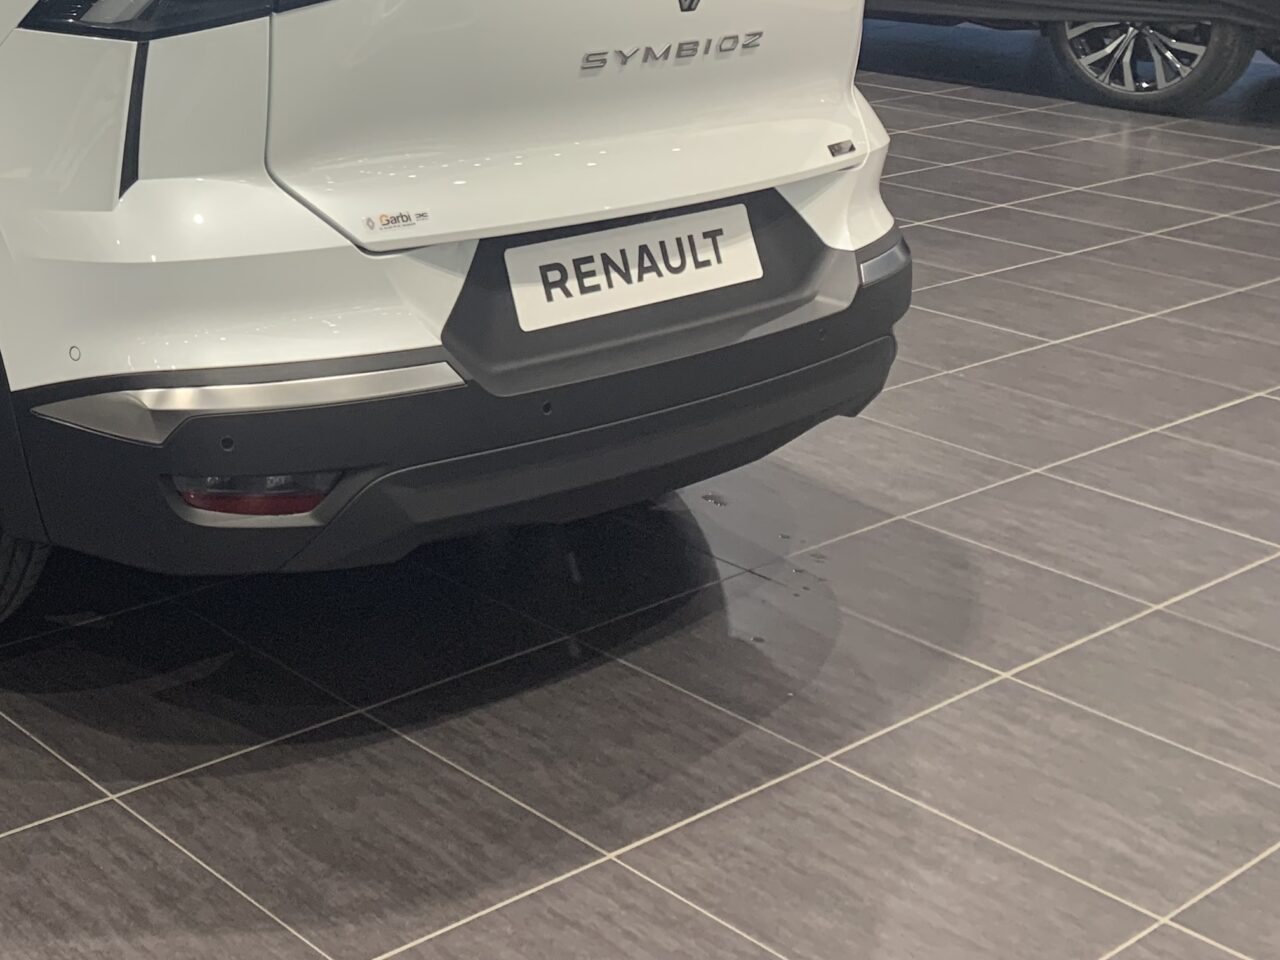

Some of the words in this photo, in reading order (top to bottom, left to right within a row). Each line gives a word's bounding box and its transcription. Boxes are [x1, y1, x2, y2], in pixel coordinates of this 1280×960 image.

[580, 31, 764, 70] SYMBIOZ
[379, 211, 412, 226] Garbi
[538, 228, 725, 303] RENAULT
